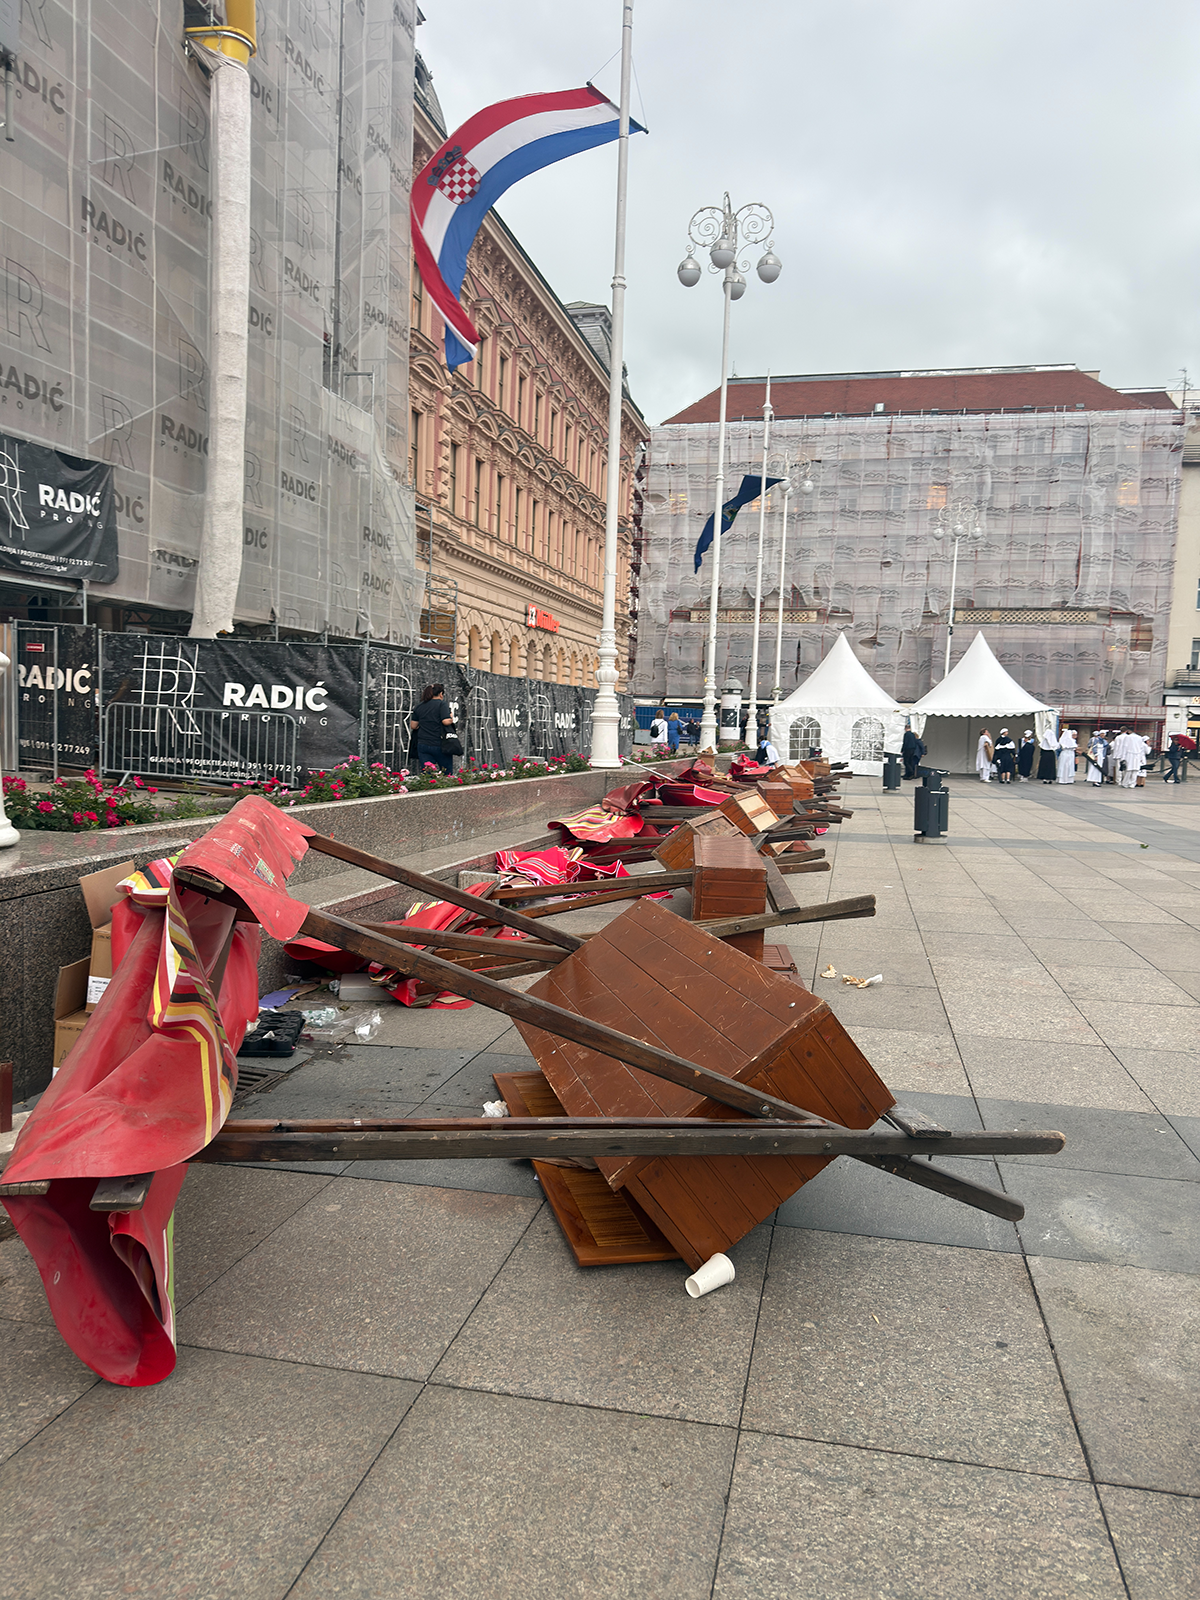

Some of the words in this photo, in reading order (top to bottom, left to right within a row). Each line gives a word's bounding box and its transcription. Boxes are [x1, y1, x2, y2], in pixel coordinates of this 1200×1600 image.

[250, 74, 272, 114] DIĆ
[81, 195, 147, 262] RADIĆ
[284, 255, 320, 303] RADIĆ
[249, 305, 272, 337] DIĆ
[38, 483, 102, 518] RADIĆ
[281, 470, 317, 502] RADIĆ
[244, 526, 268, 550] DIĆ
[222, 680, 329, 712] RADIĆ
[285, 764, 302, 773] 29
